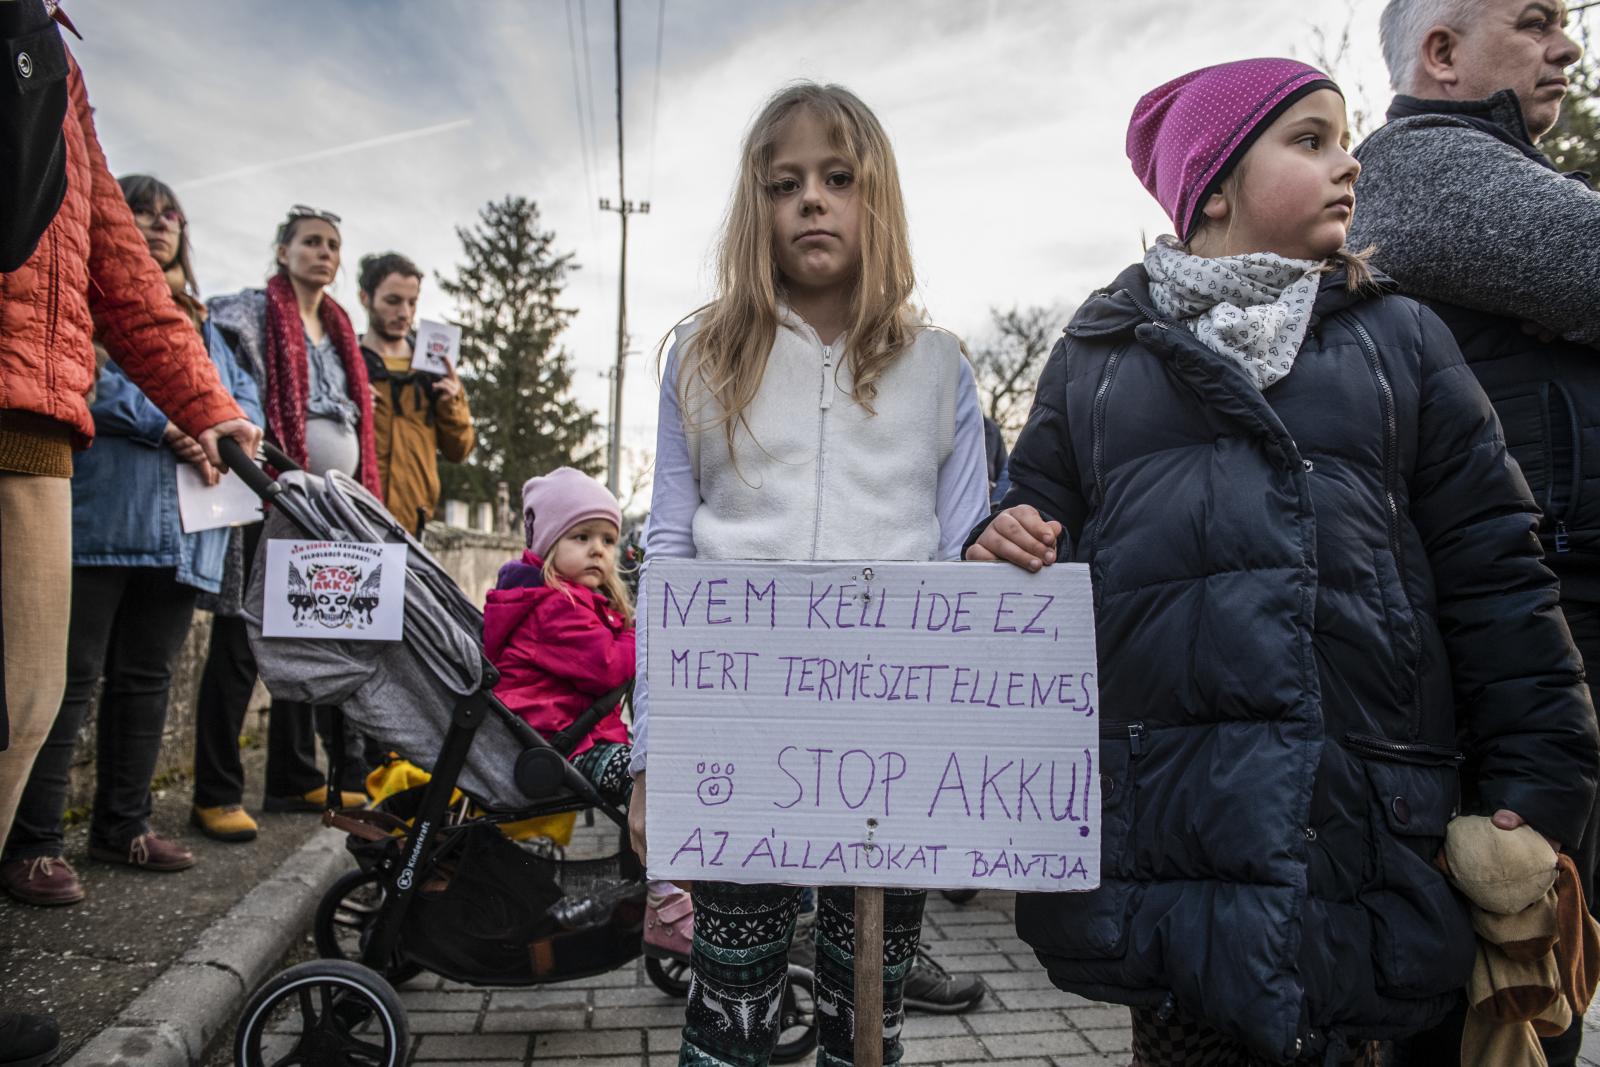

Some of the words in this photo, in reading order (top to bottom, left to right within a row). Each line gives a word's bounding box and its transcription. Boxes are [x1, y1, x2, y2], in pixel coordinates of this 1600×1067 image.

[313, 579, 352, 592] AKKU
[316, 568, 356, 585] STOP
[663, 578, 776, 629] NEM
[807, 581, 886, 629] KELL
[993, 592, 1058, 641] EZ,
[670, 649, 759, 690] MERT
[773, 746, 906, 816] STOP
[928, 748, 1091, 837] AKKU!
[407, 821, 431, 868] Kinderkraft
[670, 827, 729, 867] AZ
[741, 828, 947, 874] ÁLLATOKAT
[965, 837, 1088, 880] BÁNTJA
